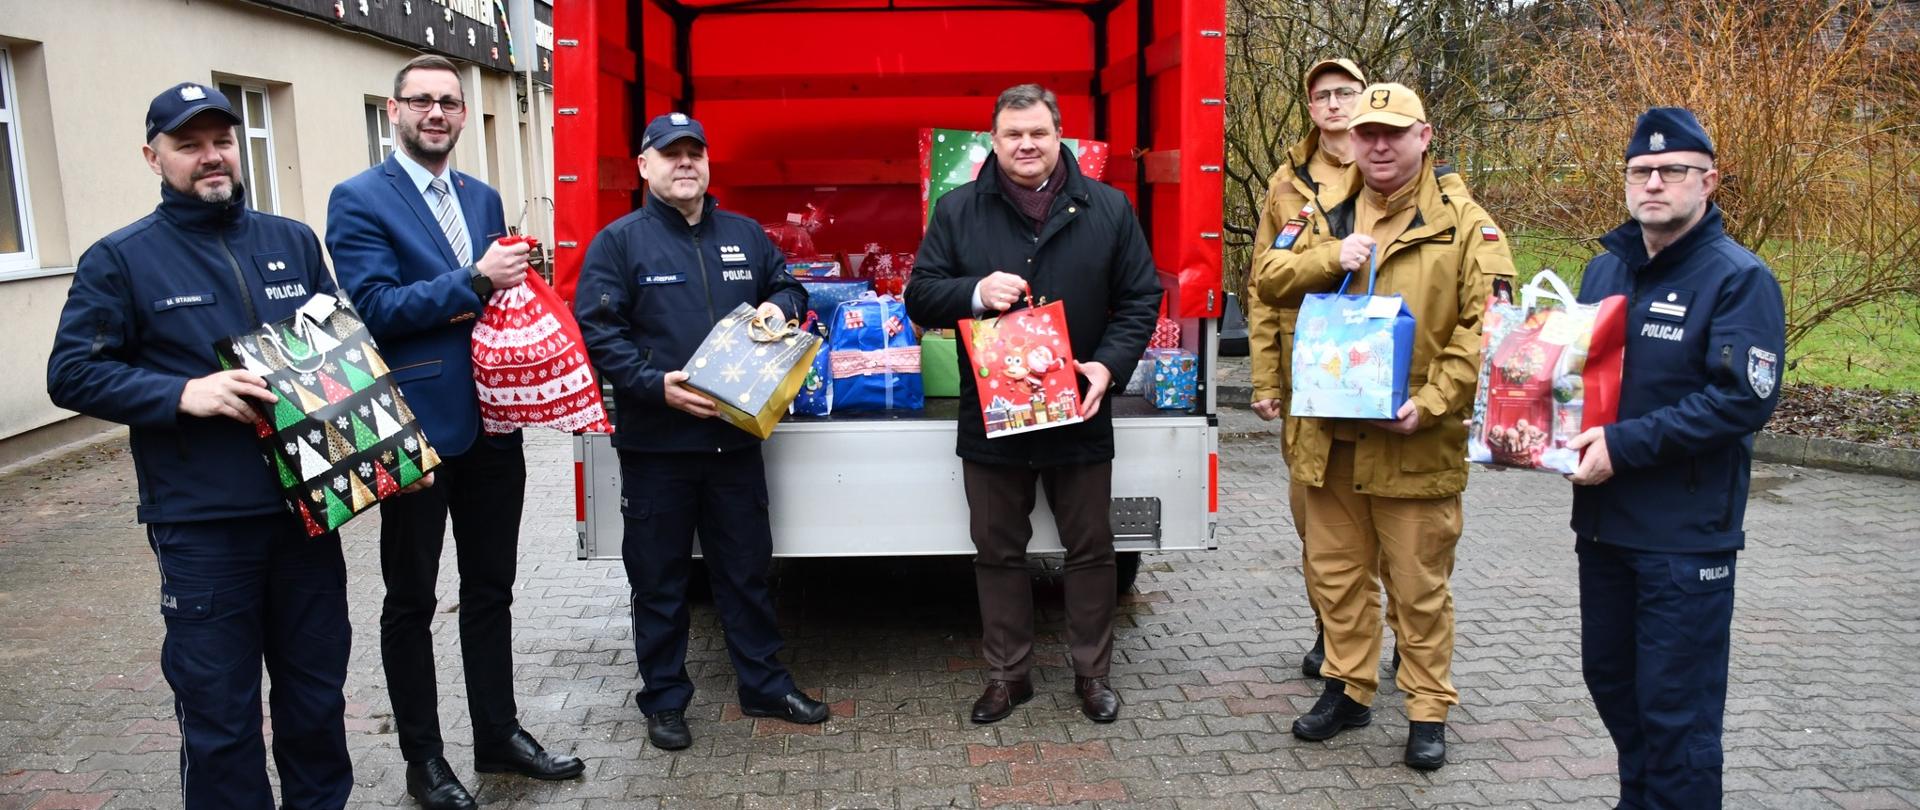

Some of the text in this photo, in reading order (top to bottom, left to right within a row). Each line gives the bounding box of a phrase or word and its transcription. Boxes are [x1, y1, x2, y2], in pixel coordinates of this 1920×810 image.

[722, 270, 753, 281] POLICJA
[264, 284, 307, 300] POLICJA
[1640, 323, 1684, 341] POLICJA
[1751, 348, 1776, 362] POLICJA
[1699, 565, 1729, 581] POLICJA
